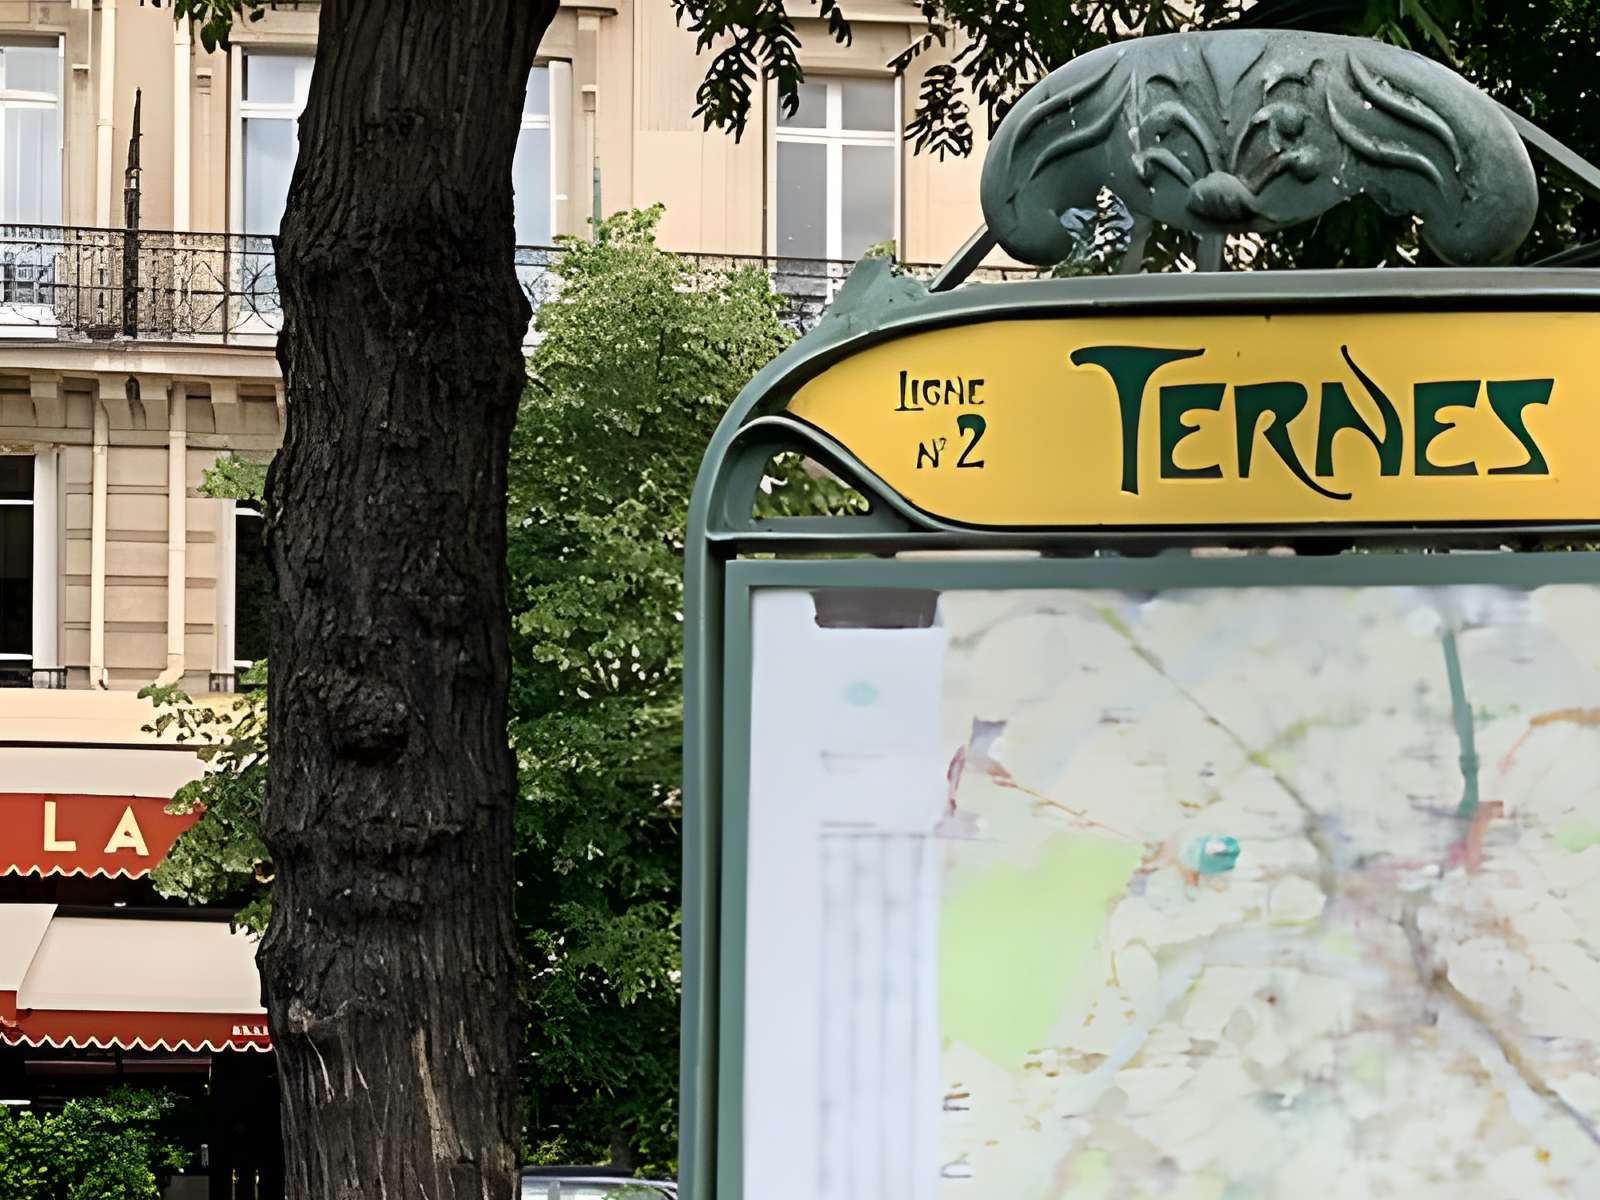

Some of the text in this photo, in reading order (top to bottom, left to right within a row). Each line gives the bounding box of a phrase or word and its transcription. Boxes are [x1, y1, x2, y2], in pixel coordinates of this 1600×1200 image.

[894, 370, 985, 412] LIGNE
[956, 413, 987, 469] 2
[1069, 344, 1555, 500] TERNES
